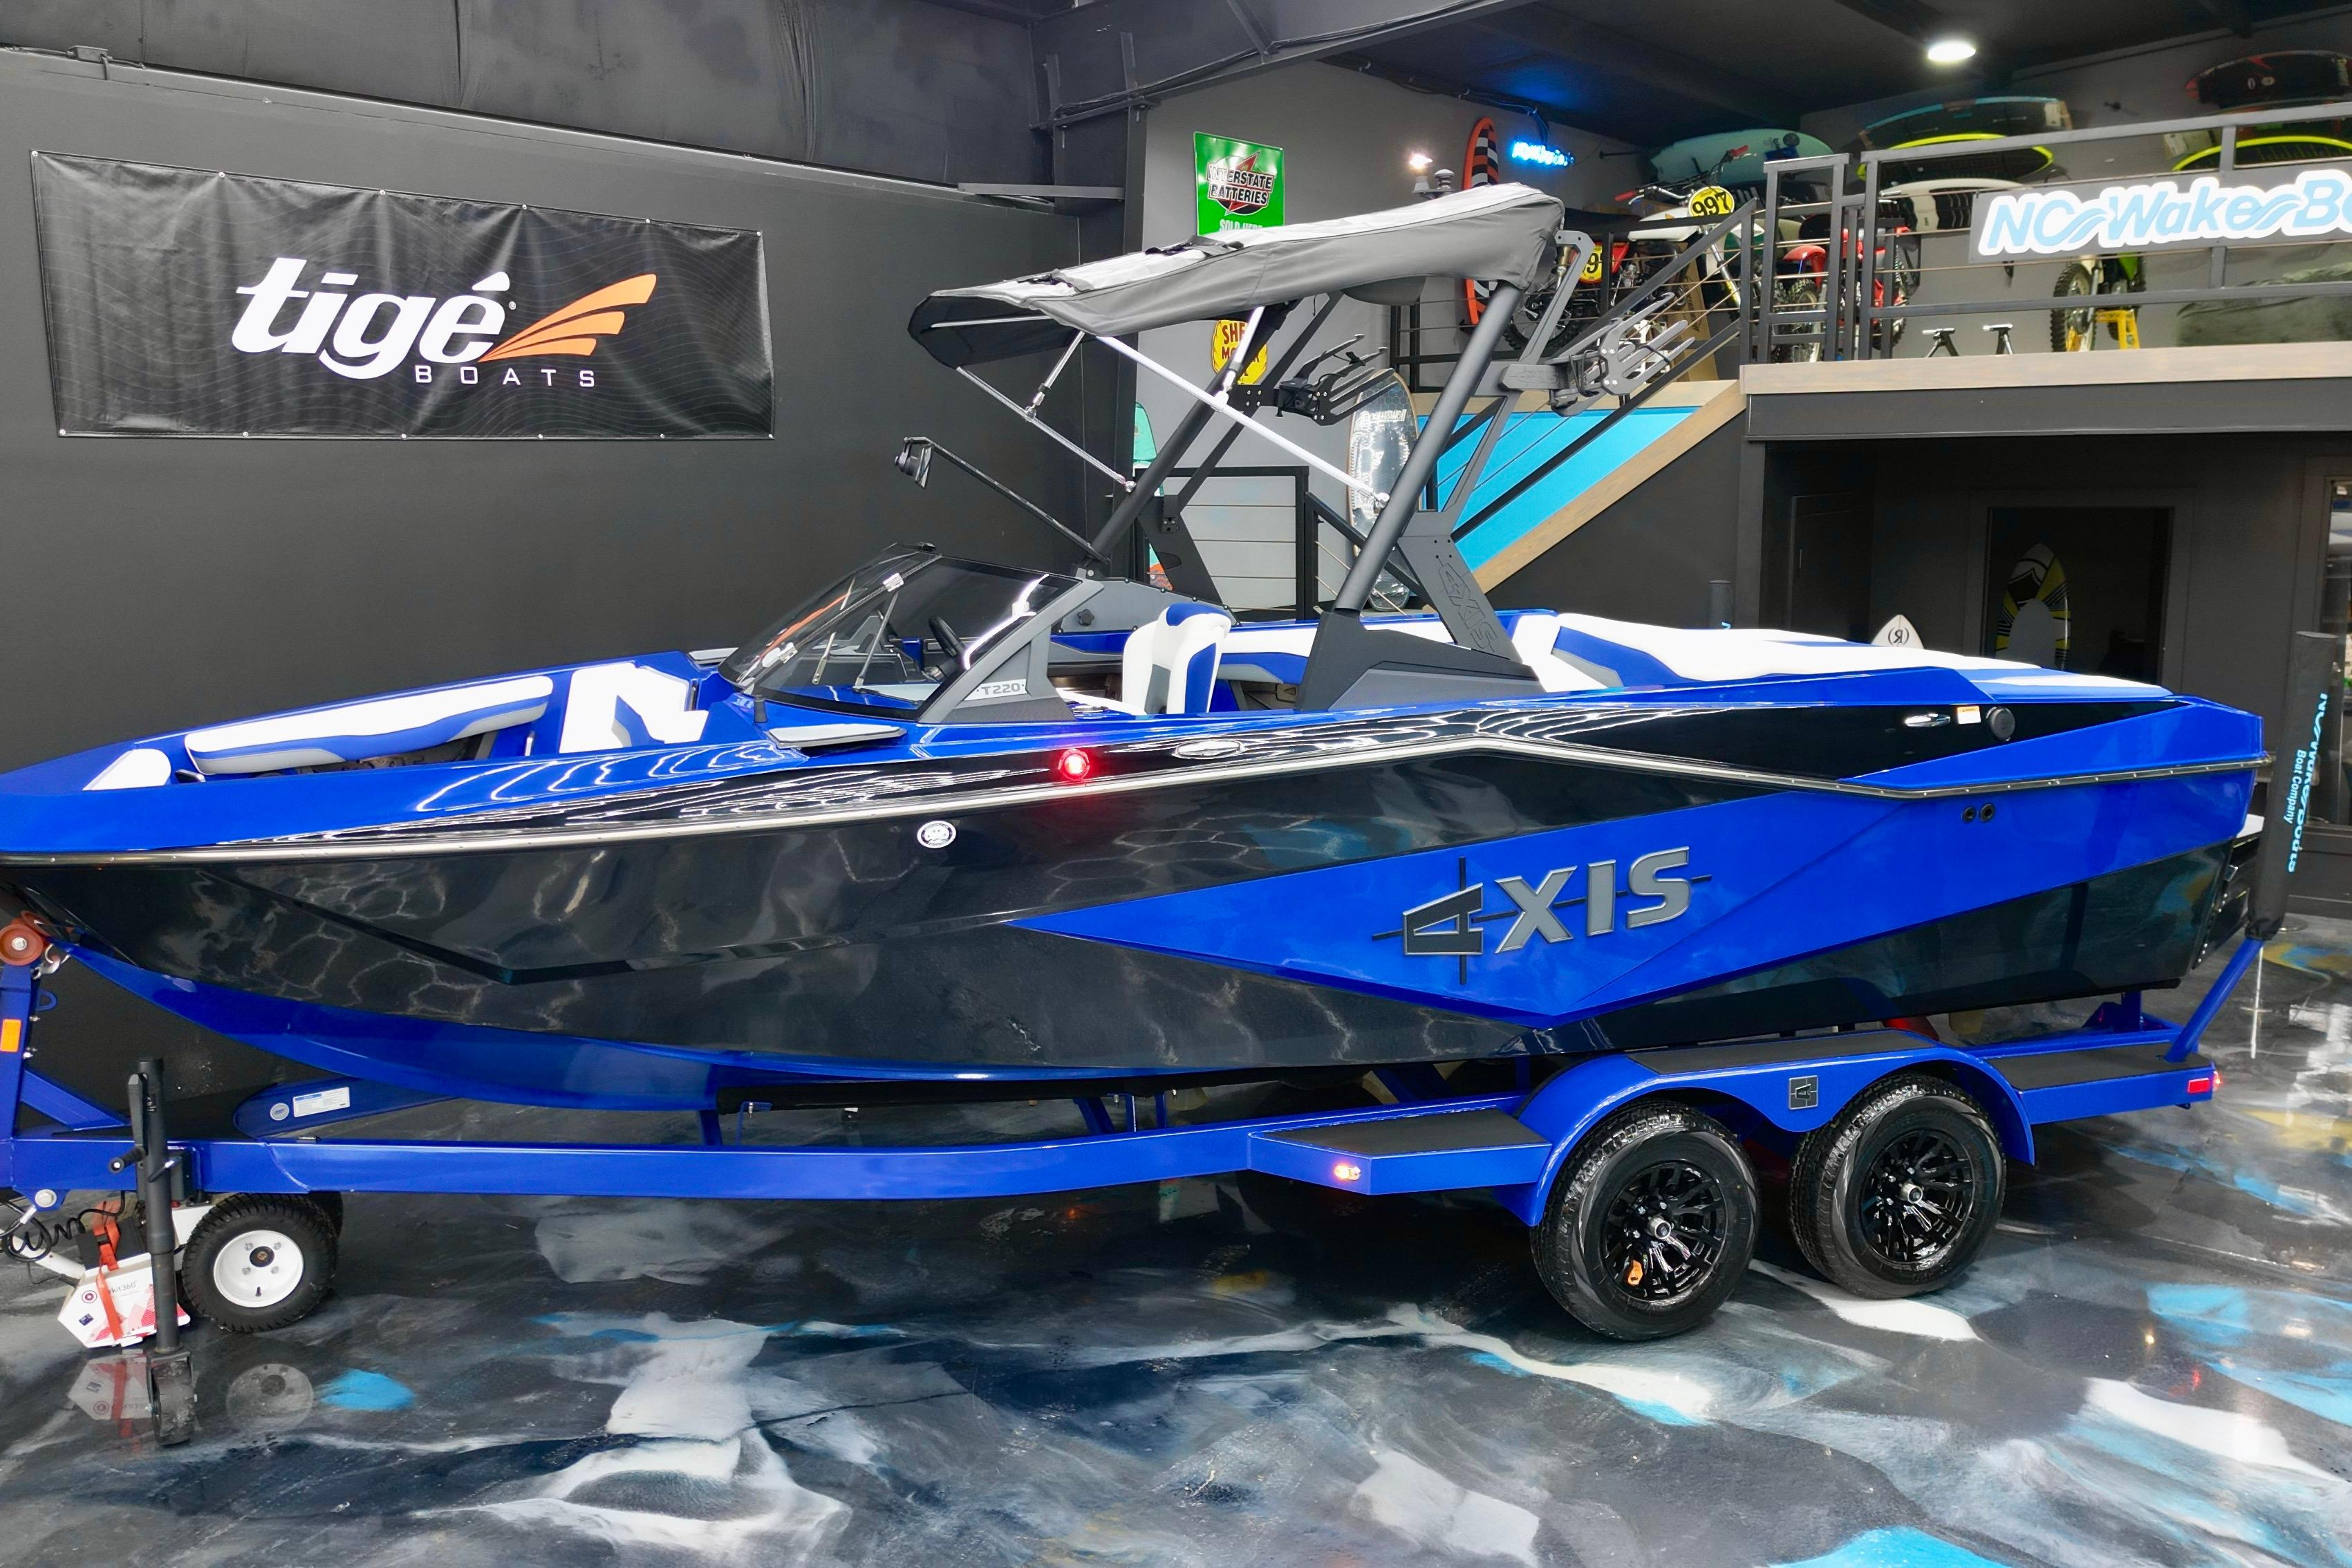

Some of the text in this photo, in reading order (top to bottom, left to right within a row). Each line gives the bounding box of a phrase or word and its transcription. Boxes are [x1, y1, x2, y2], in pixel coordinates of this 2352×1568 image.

[1208, 165, 1273, 189] INTERSTATE
[1211, 183, 1268, 205] BATTERIES
[1692, 191, 1731, 216] 997
[1987, 198, 2082, 249] NC
[2108, 186, 2265, 240] Wake
[415, 365, 595, 387] BOATS
[981, 682, 1021, 696] T220
[2284, 749, 2307, 824] Boat Company
[1403, 846, 1691, 956] AXIS
